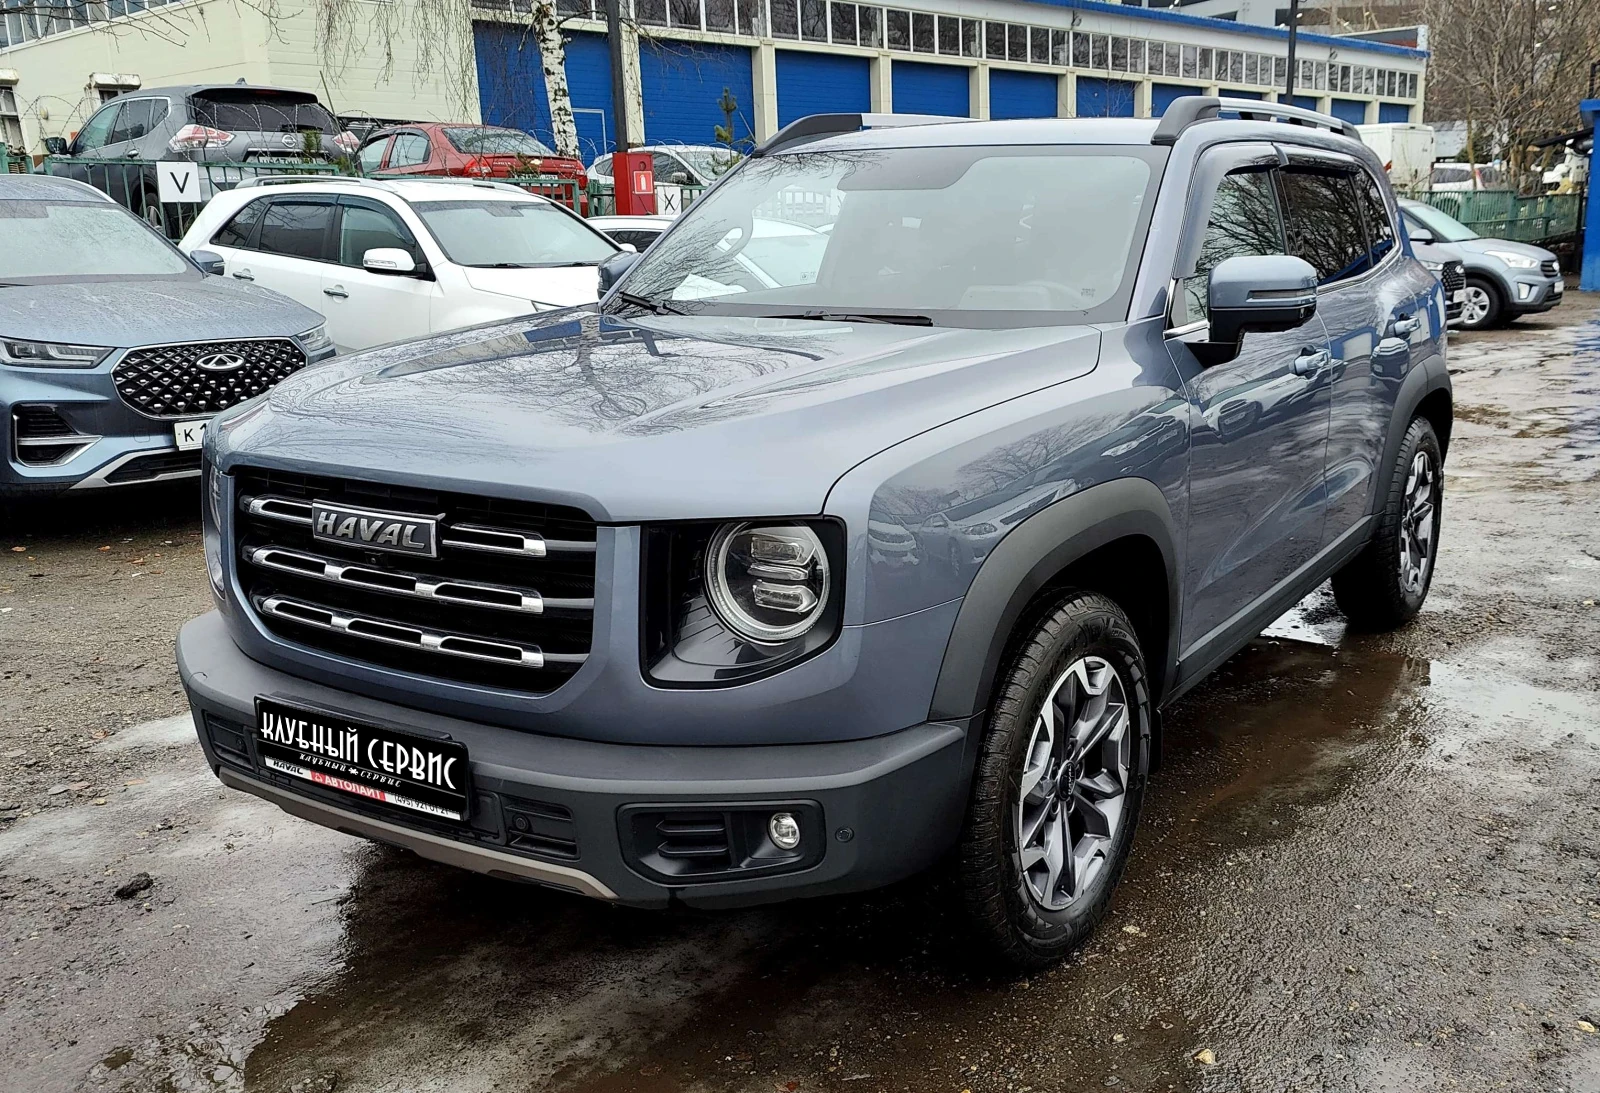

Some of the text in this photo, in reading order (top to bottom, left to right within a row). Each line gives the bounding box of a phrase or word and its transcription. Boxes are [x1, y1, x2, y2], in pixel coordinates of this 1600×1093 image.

[169, 171, 190, 194] V
[664, 193, 675, 211] X
[316, 511, 425, 549] HAVAL
[260, 711, 458, 790] КЛУБНЫЙ СЕРВИС
[272, 760, 304, 776] HAVAL
[359, 770, 402, 788] СЕРВИС
